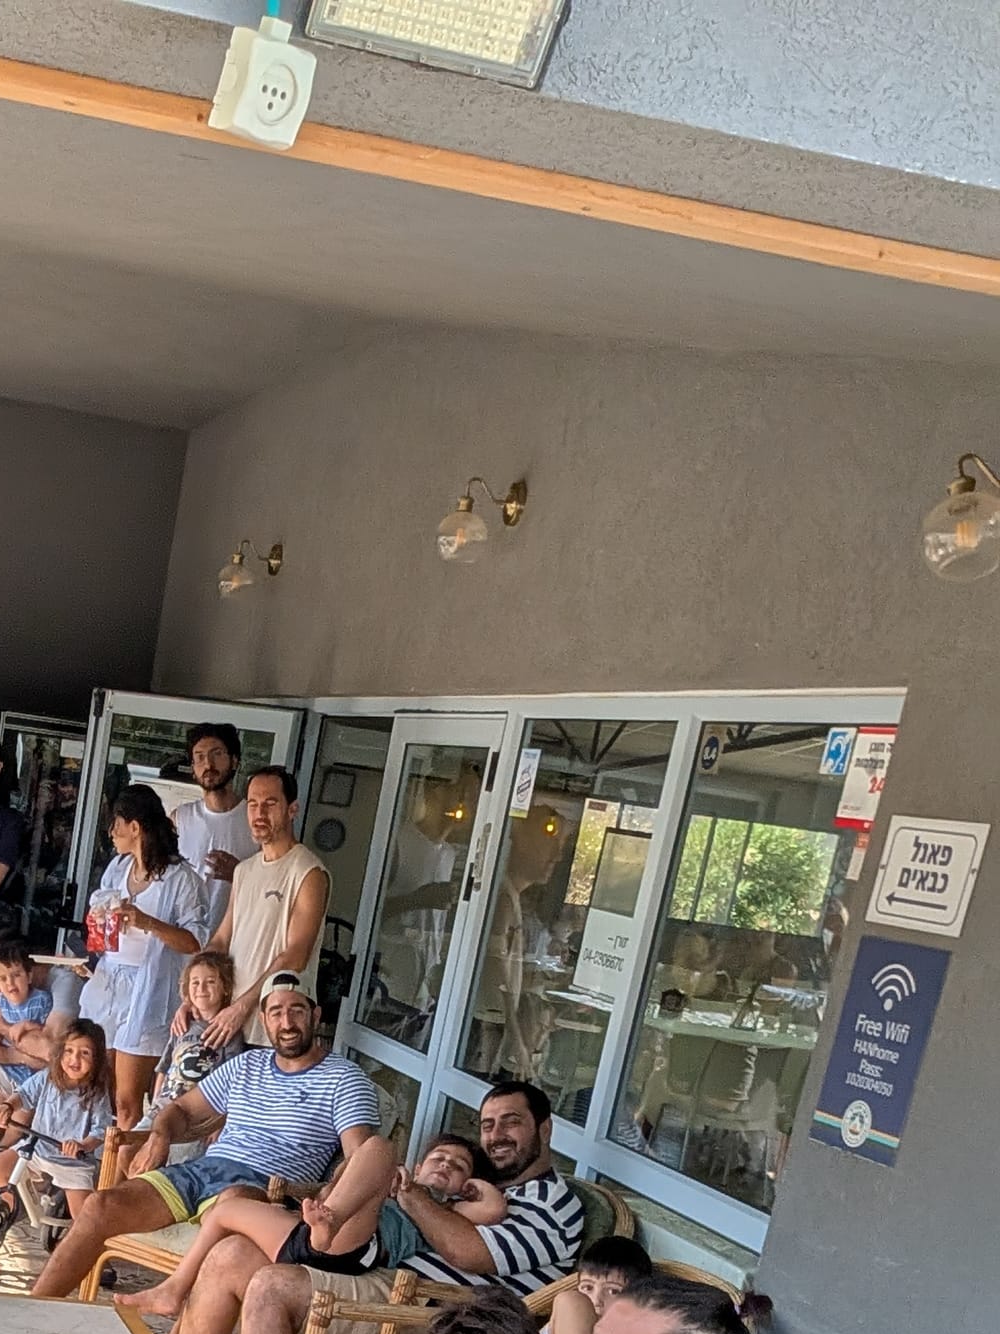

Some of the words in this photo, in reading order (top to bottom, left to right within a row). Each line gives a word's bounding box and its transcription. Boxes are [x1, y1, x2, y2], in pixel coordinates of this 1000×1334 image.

[911, 836, 953, 866] פאנל
[897, 867, 949, 894] כבאים
[855, 1014, 882, 1037] Free
[885, 1021, 910, 1044] Wifi
